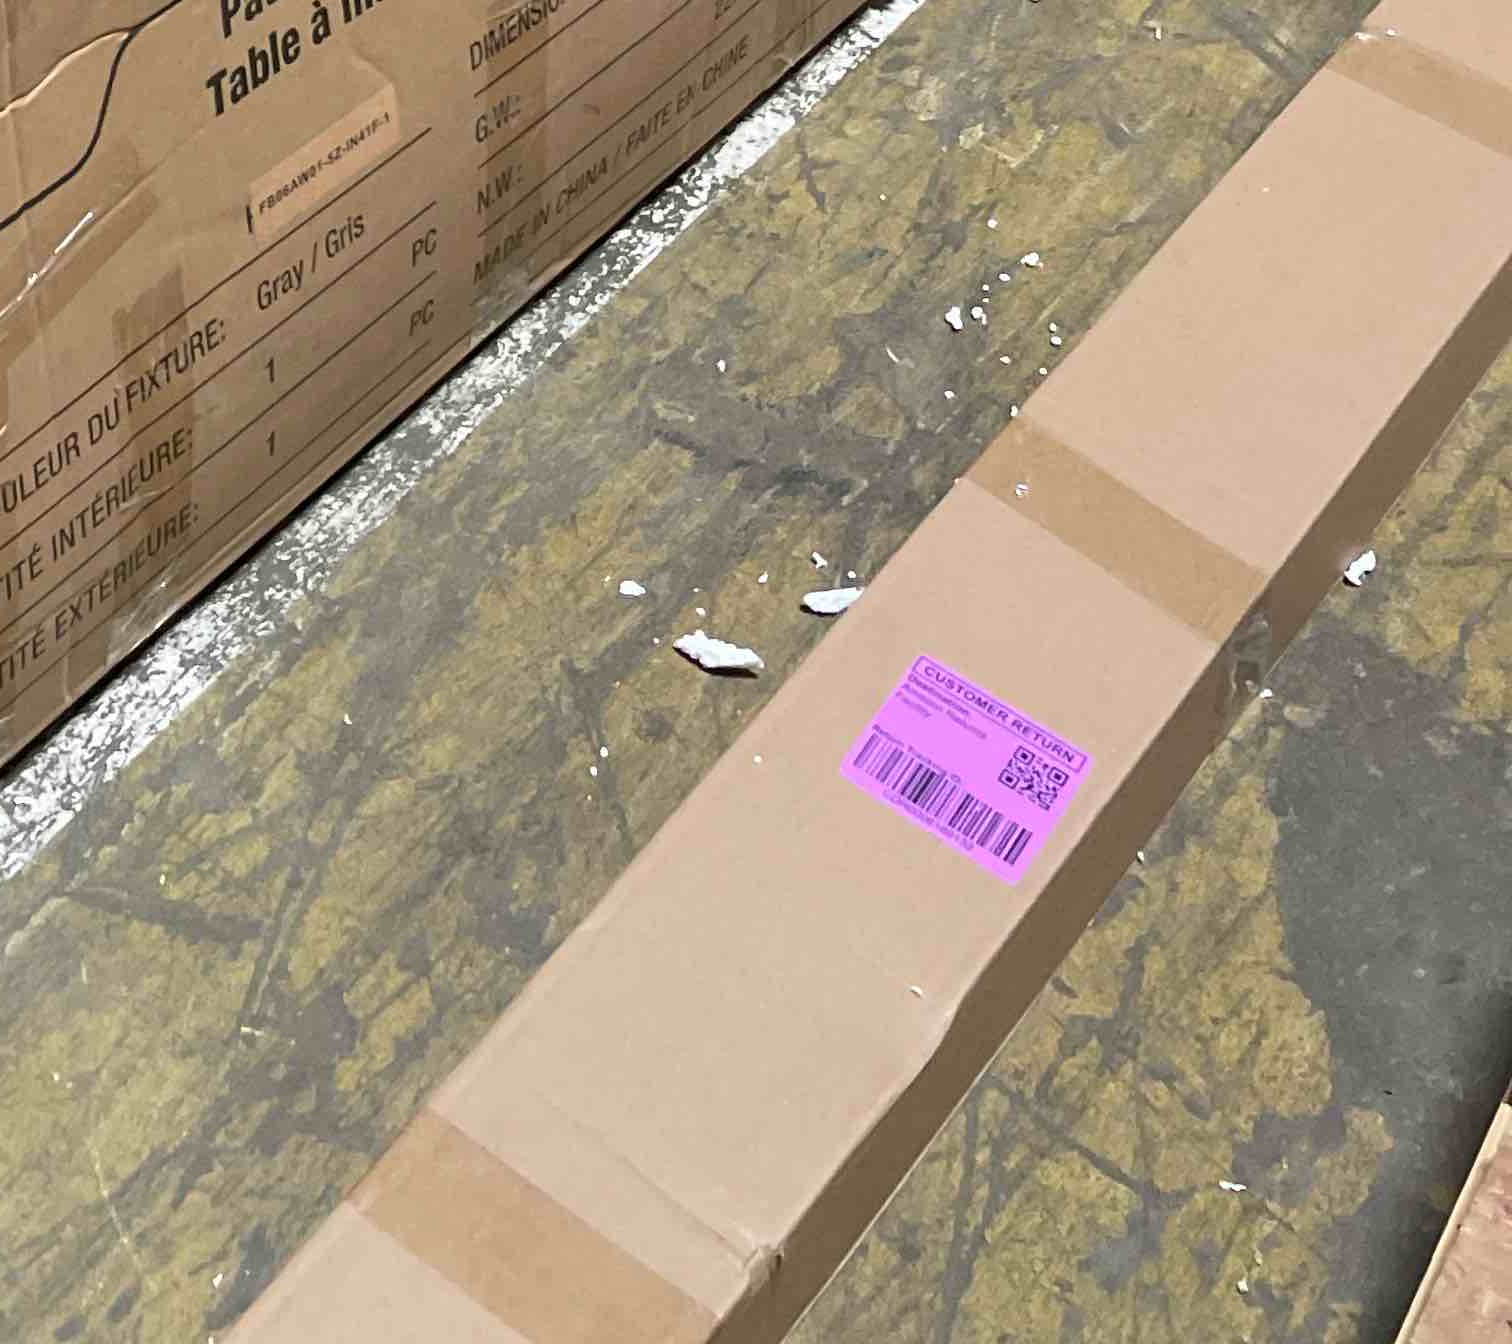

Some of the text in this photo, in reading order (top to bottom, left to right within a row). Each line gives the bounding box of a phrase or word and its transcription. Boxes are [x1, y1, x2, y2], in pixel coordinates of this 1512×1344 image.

[205, 26, 302, 118] Table
[310, 0, 333, 46] à
[474, 92, 521, 143] G.W.:
[473, 226, 534, 286] MADE
[554, 156, 610, 217] CHINA
[624, 106, 673, 159] FAITE
[700, 33, 752, 93] CHINE
[476, 162, 523, 217] N.W.:
[51, 427, 194, 563] INTÉRIEURE:
[264, 356, 276, 384] 1
[410, 227, 438, 268] PC
[88, 395, 122, 446] DU
[126, 316, 227, 414] FIXTURE:
[255, 259, 305, 311] Gray
[311, 241, 319, 275] /
[324, 213, 366, 261] Gris
[55, 499, 201, 642] EXTÉRIEURE:
[265, 430, 276, 458] 1
[408, 297, 436, 339] PC
[923, 664, 1010, 724] CUSTOMER
[1010, 717, 1076, 765] RETURN
